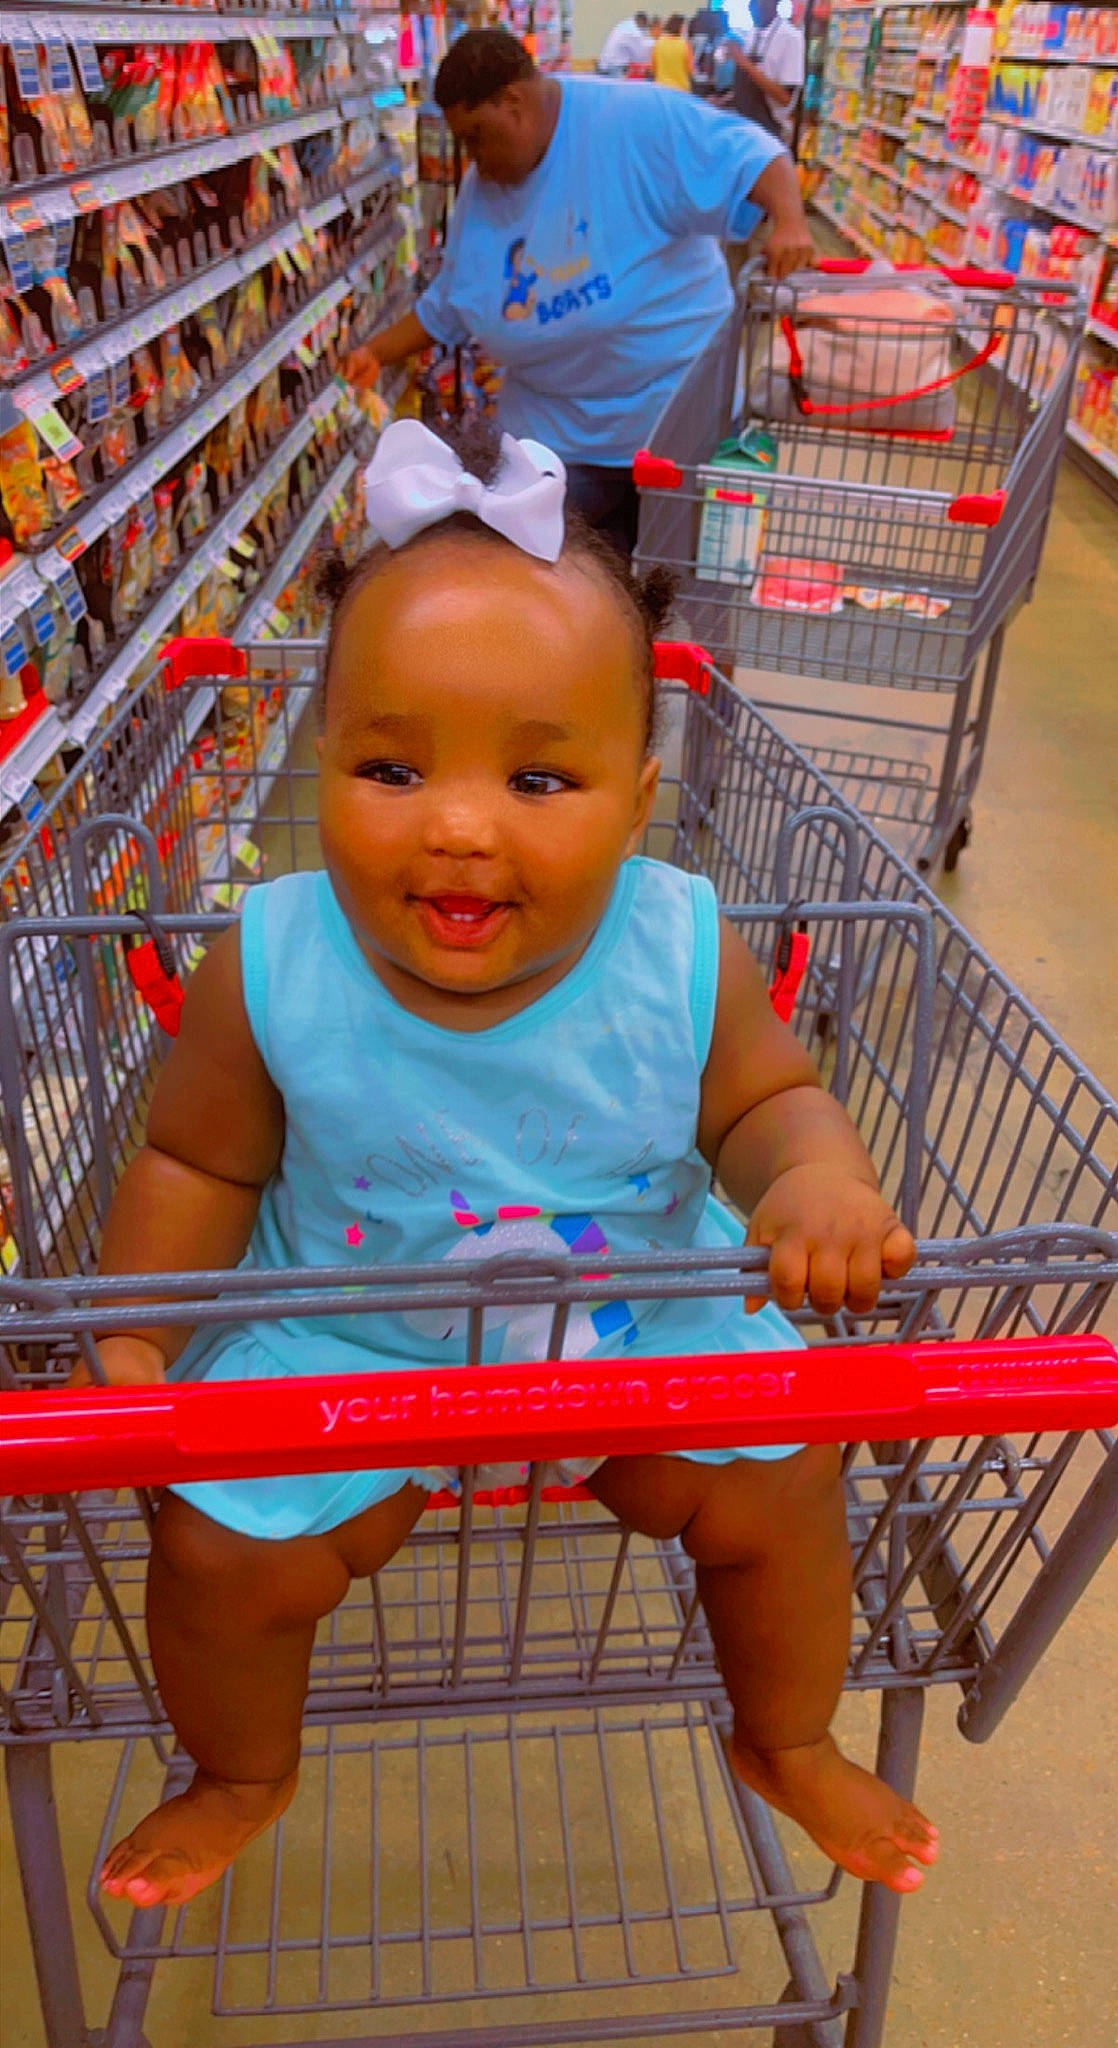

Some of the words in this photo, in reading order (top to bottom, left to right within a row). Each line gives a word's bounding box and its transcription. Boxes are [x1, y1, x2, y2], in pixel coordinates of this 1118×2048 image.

[366, 1108, 484, 1198] ONE
[516, 1106, 588, 1167] OF
[320, 1393, 419, 1434] your
[430, 1378, 650, 1418] hometown
[664, 1370, 797, 1411] grocer
